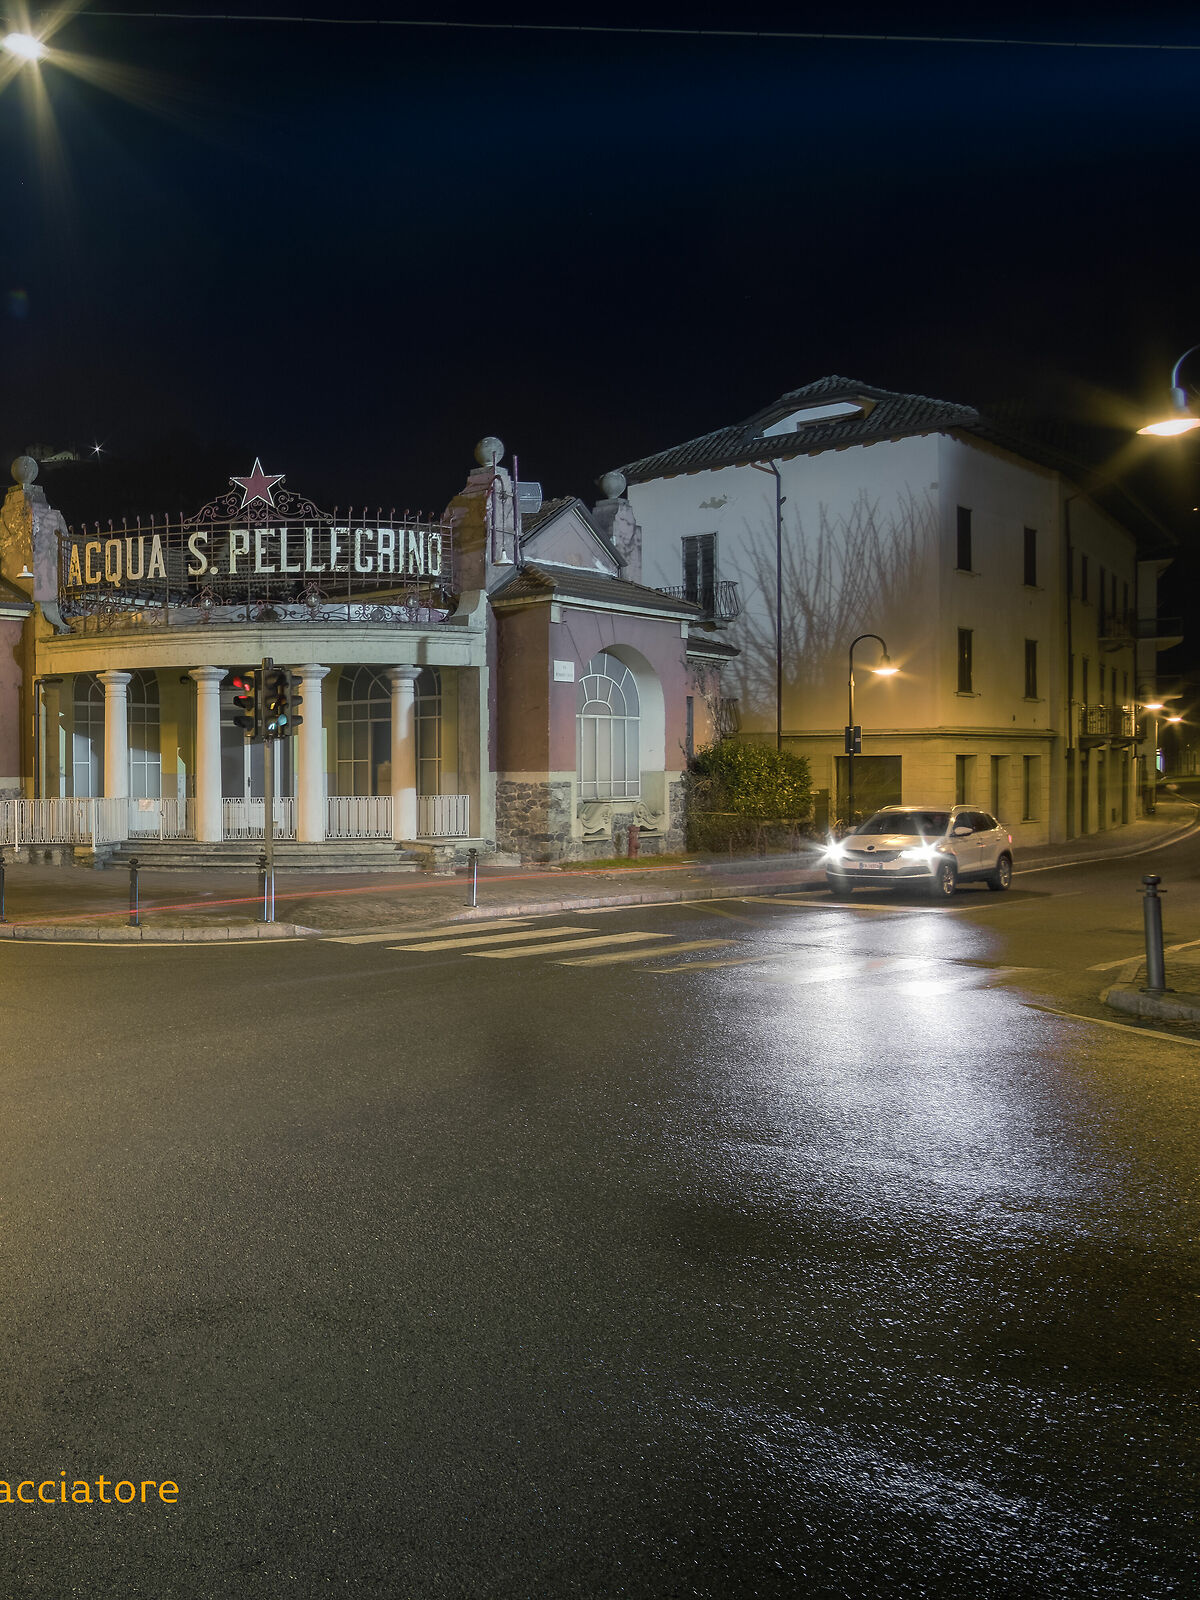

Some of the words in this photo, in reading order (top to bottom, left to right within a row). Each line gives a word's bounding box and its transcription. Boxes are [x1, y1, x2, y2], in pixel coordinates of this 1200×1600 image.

[67, 534, 167, 588] ACQUA
[188, 531, 219, 576] S.
[228, 527, 442, 577] PELLEGRINO
